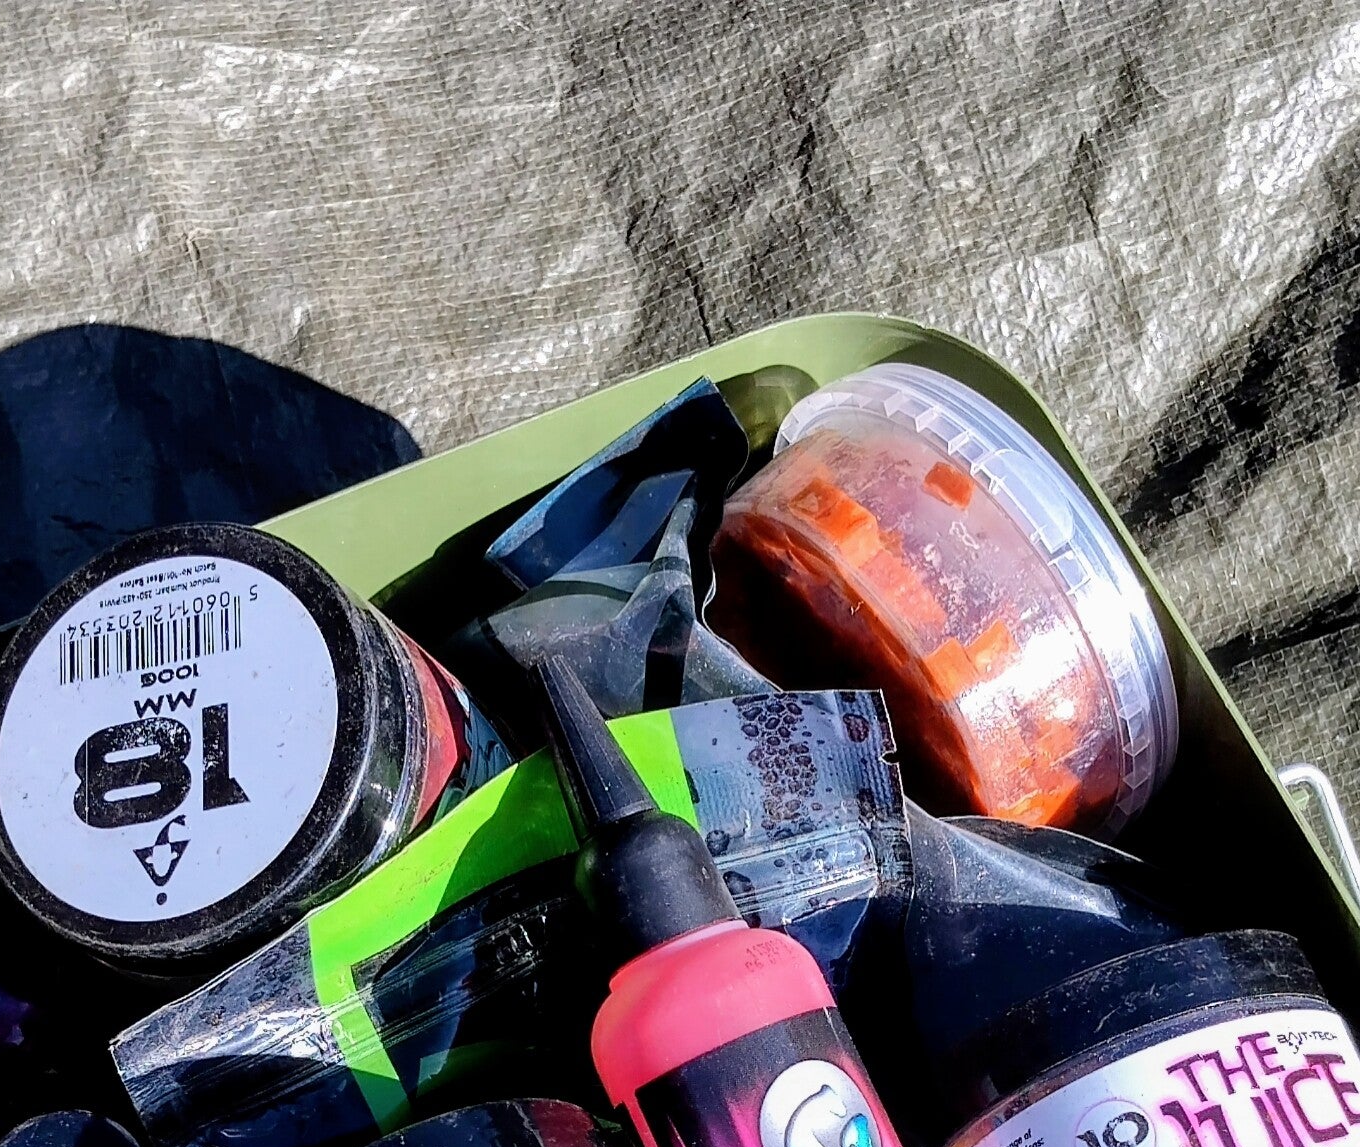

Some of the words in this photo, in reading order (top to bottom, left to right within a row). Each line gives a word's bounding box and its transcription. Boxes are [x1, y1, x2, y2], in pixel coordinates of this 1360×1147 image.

[189, 575, 220, 588] Product
[249, 585, 258, 601] 5
[141, 663, 199, 688] 100G
[134, 688, 197, 717] MM
[74, 703, 250, 829] 18
[1167, 1031, 1285, 1101] THE
[1023, 1128, 1032, 1140] of
